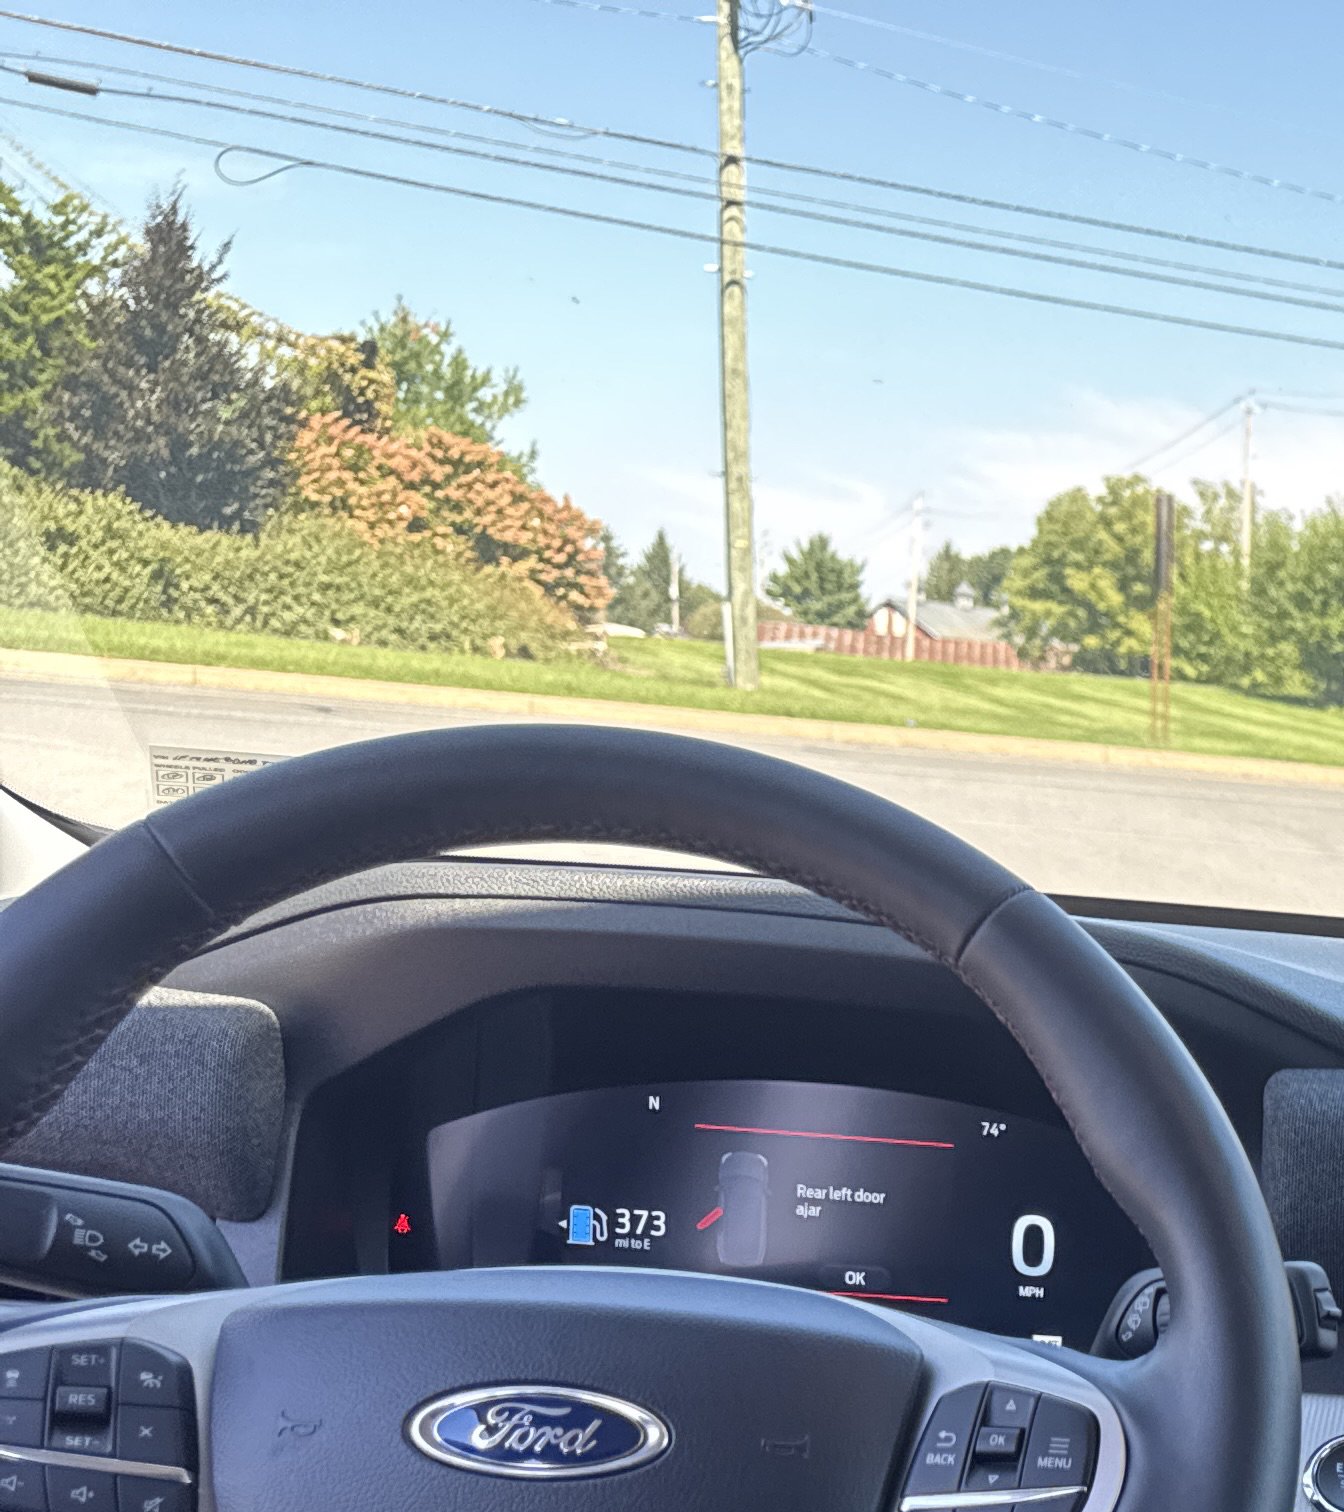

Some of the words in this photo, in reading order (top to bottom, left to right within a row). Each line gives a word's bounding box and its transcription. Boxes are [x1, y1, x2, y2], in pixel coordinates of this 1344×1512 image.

[648, 1095, 660, 1111] N
[981, 1121, 1007, 1138] 74°
[796, 1183, 828, 1200] Rear
[829, 1186, 852, 1202] left
[854, 1187, 886, 1204] door
[795, 1203, 822, 1218] ajar
[614, 1208, 666, 1237] 373
[614, 1238, 629, 1249] mi
[630, 1239, 643, 1250] to
[643, 1239, 651, 1250] E
[1011, 1213, 1056, 1277] 0
[844, 1270, 866, 1286] OK
[1018, 1286, 1045, 1298] MPH
[68, 1393, 96, 1406] RES
[471, 1403, 603, 1456] Ford
[989, 1434, 1006, 1446] OK
[925, 1453, 955, 1465] BACK
[1037, 1455, 1072, 1469] MENU
